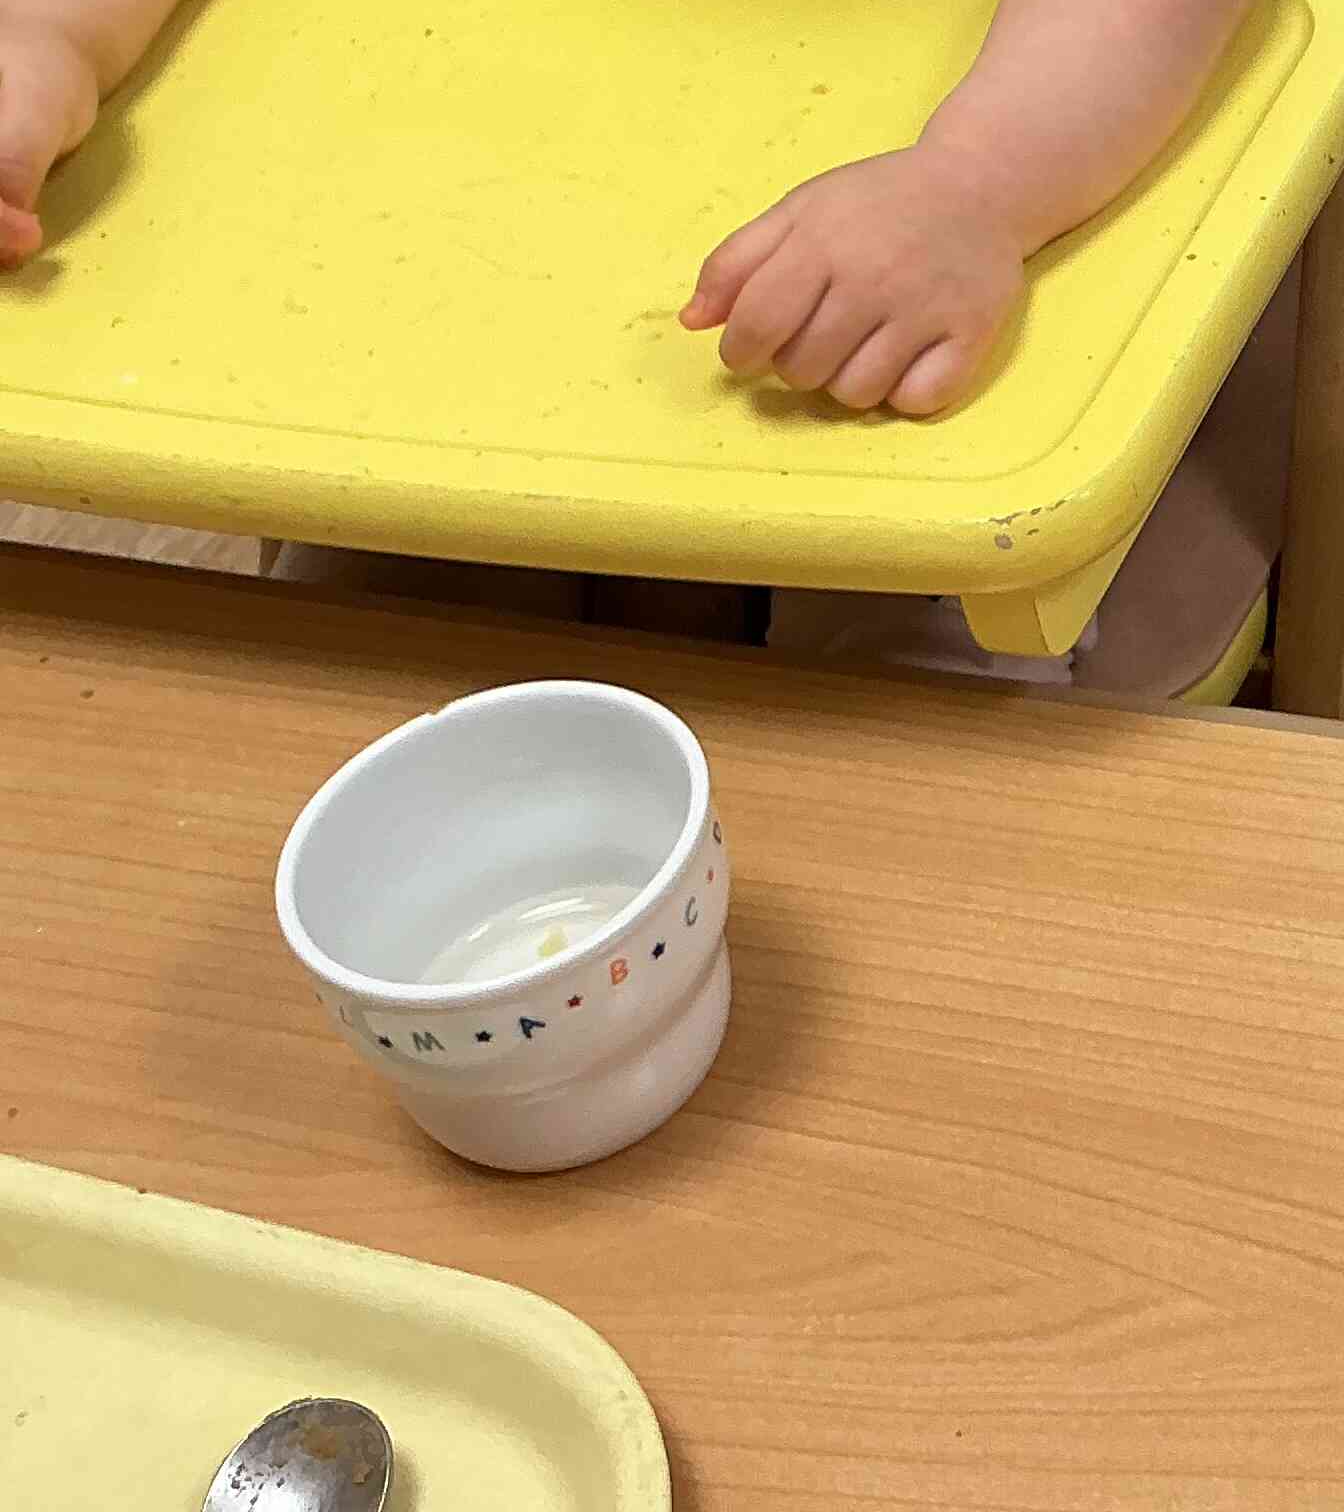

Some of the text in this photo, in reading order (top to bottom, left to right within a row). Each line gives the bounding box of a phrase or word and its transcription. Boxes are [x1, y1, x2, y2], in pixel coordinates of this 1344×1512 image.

[412, 1031, 445, 1052] M
[519, 1017, 546, 1040] A
[609, 959, 629, 986] B
[684, 896, 698, 927] C
